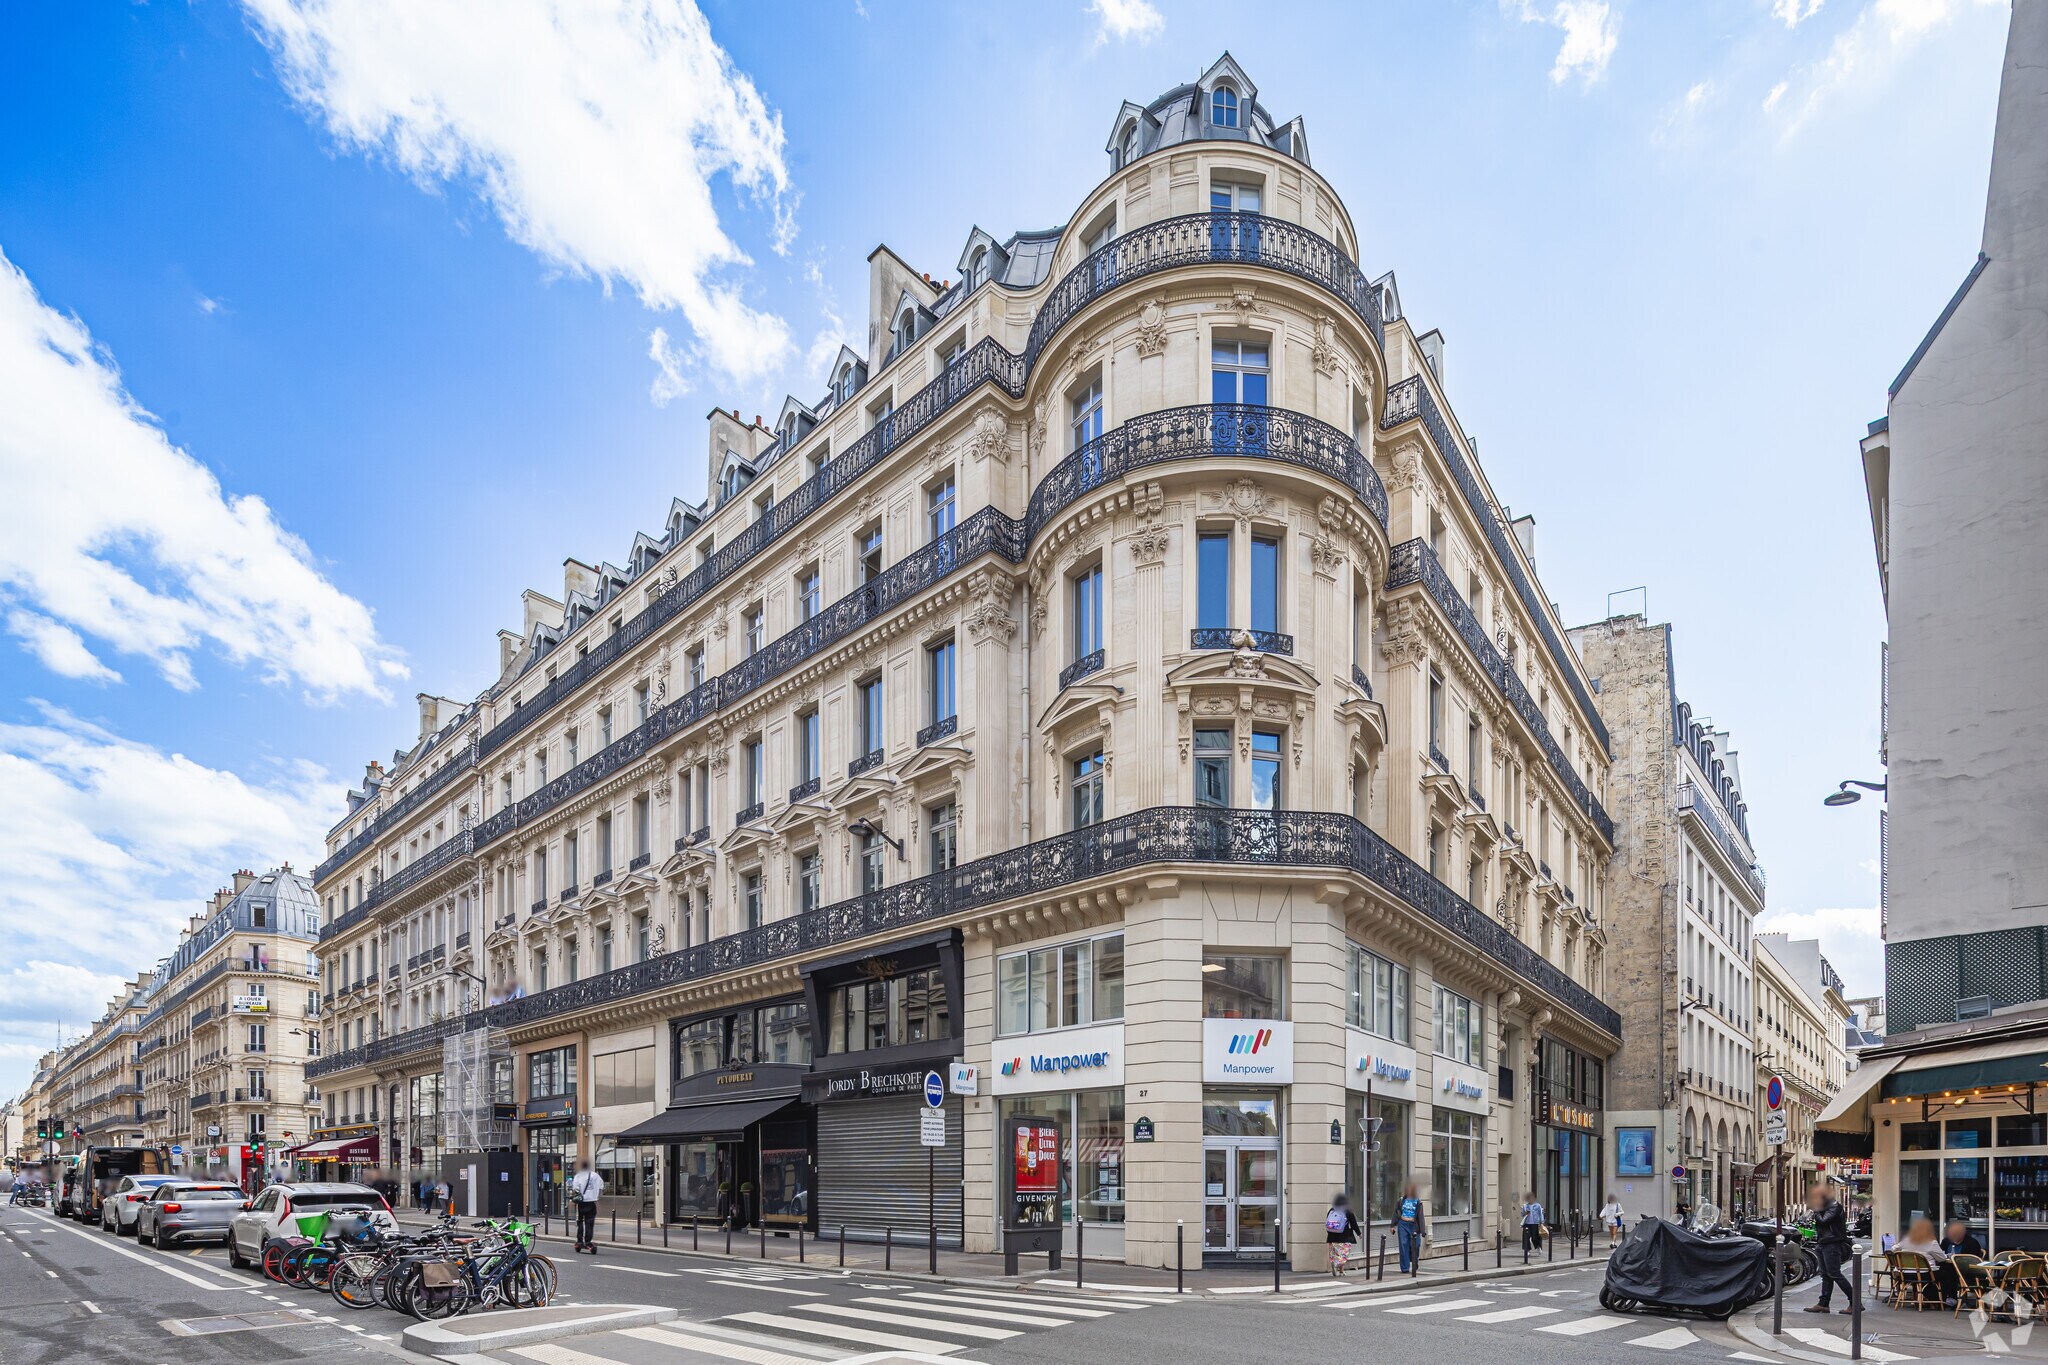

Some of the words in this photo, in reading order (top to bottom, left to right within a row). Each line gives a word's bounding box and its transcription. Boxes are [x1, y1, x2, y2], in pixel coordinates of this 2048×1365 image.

[1030, 1051, 1109, 1074] Manpower
[1223, 1064, 1274, 1075] Manpower
[1375, 1057, 1411, 1081] Manpower
[827, 1078, 856, 1097] JORDY
[1457, 1079, 1483, 1098] Manpower
[1552, 1102, 1594, 1129] L'USINE
[1038, 1139, 1055, 1150] ULTRA
[1038, 1150, 1056, 1161] DOUCE
[1016, 1195, 1057, 1203] GIVENCHY
